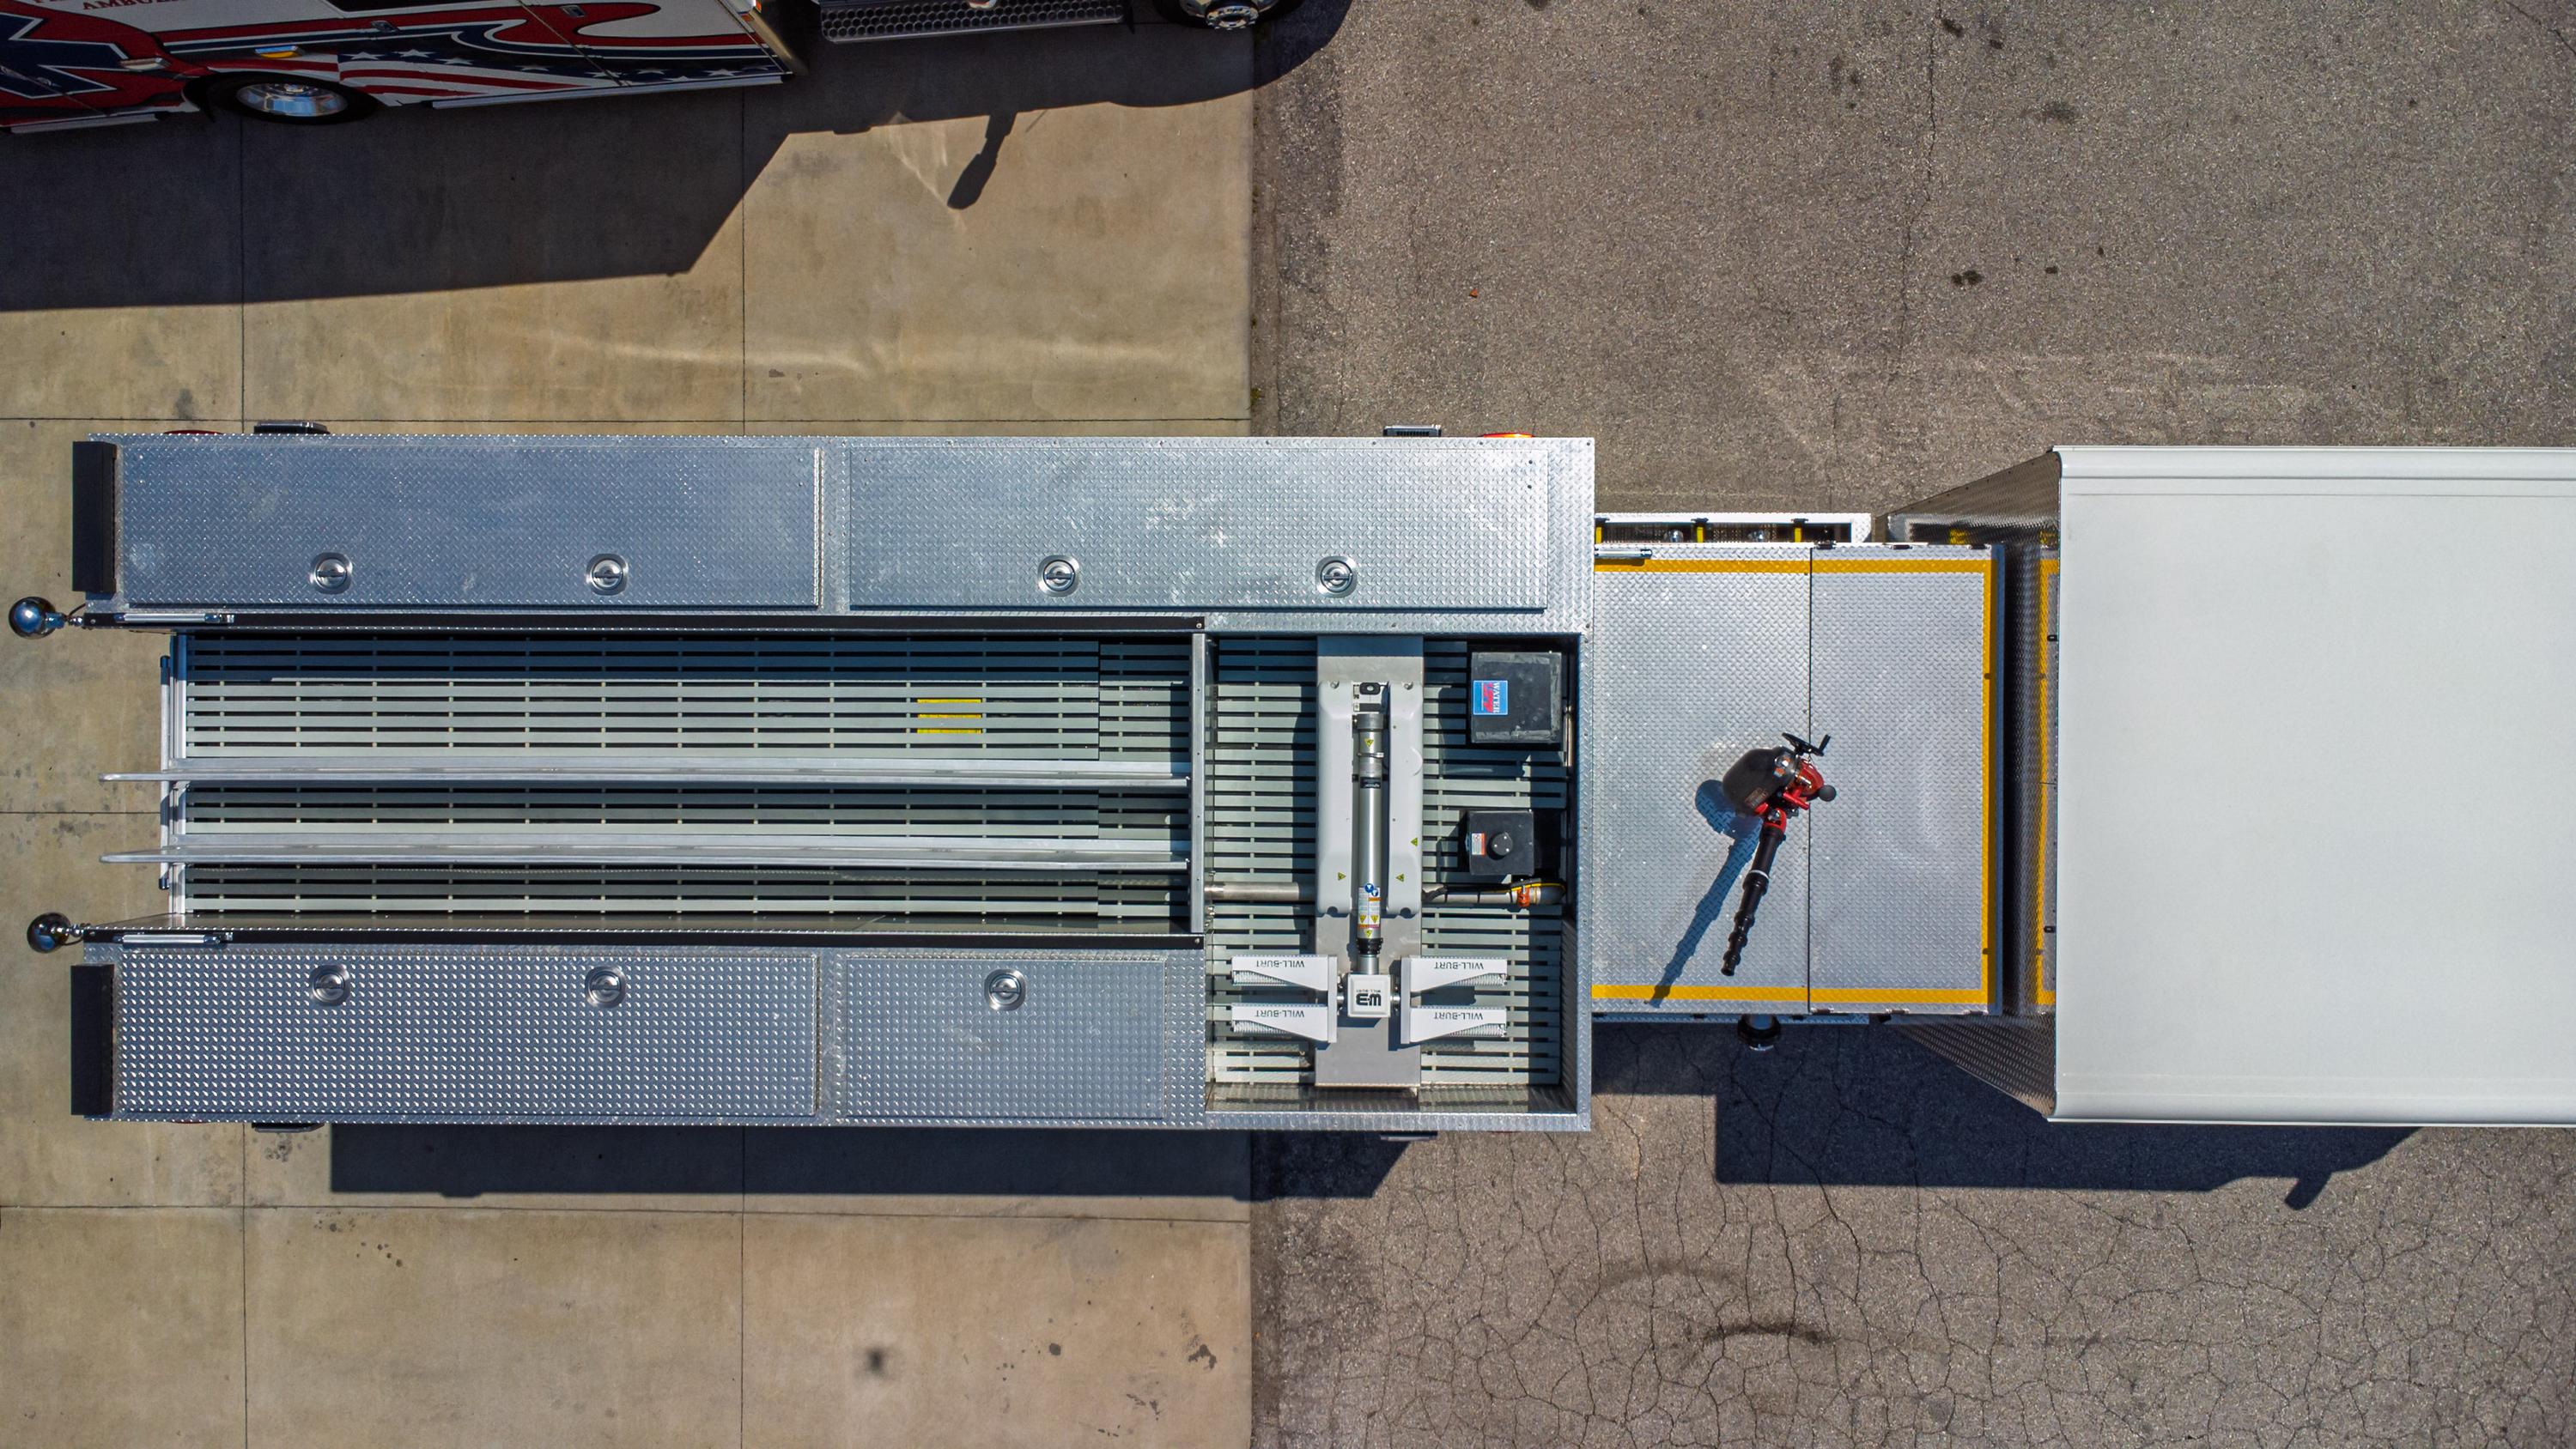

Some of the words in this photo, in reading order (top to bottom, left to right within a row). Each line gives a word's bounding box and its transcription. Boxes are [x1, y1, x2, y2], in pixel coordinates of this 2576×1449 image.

[1256, 960, 1305, 968] WILL-BURT
[1434, 961, 1485, 970] WILL-BURT
[1255, 1009, 1305, 1018] WILL-BURT
[1433, 1011, 1484, 1021] WILL-BURT
